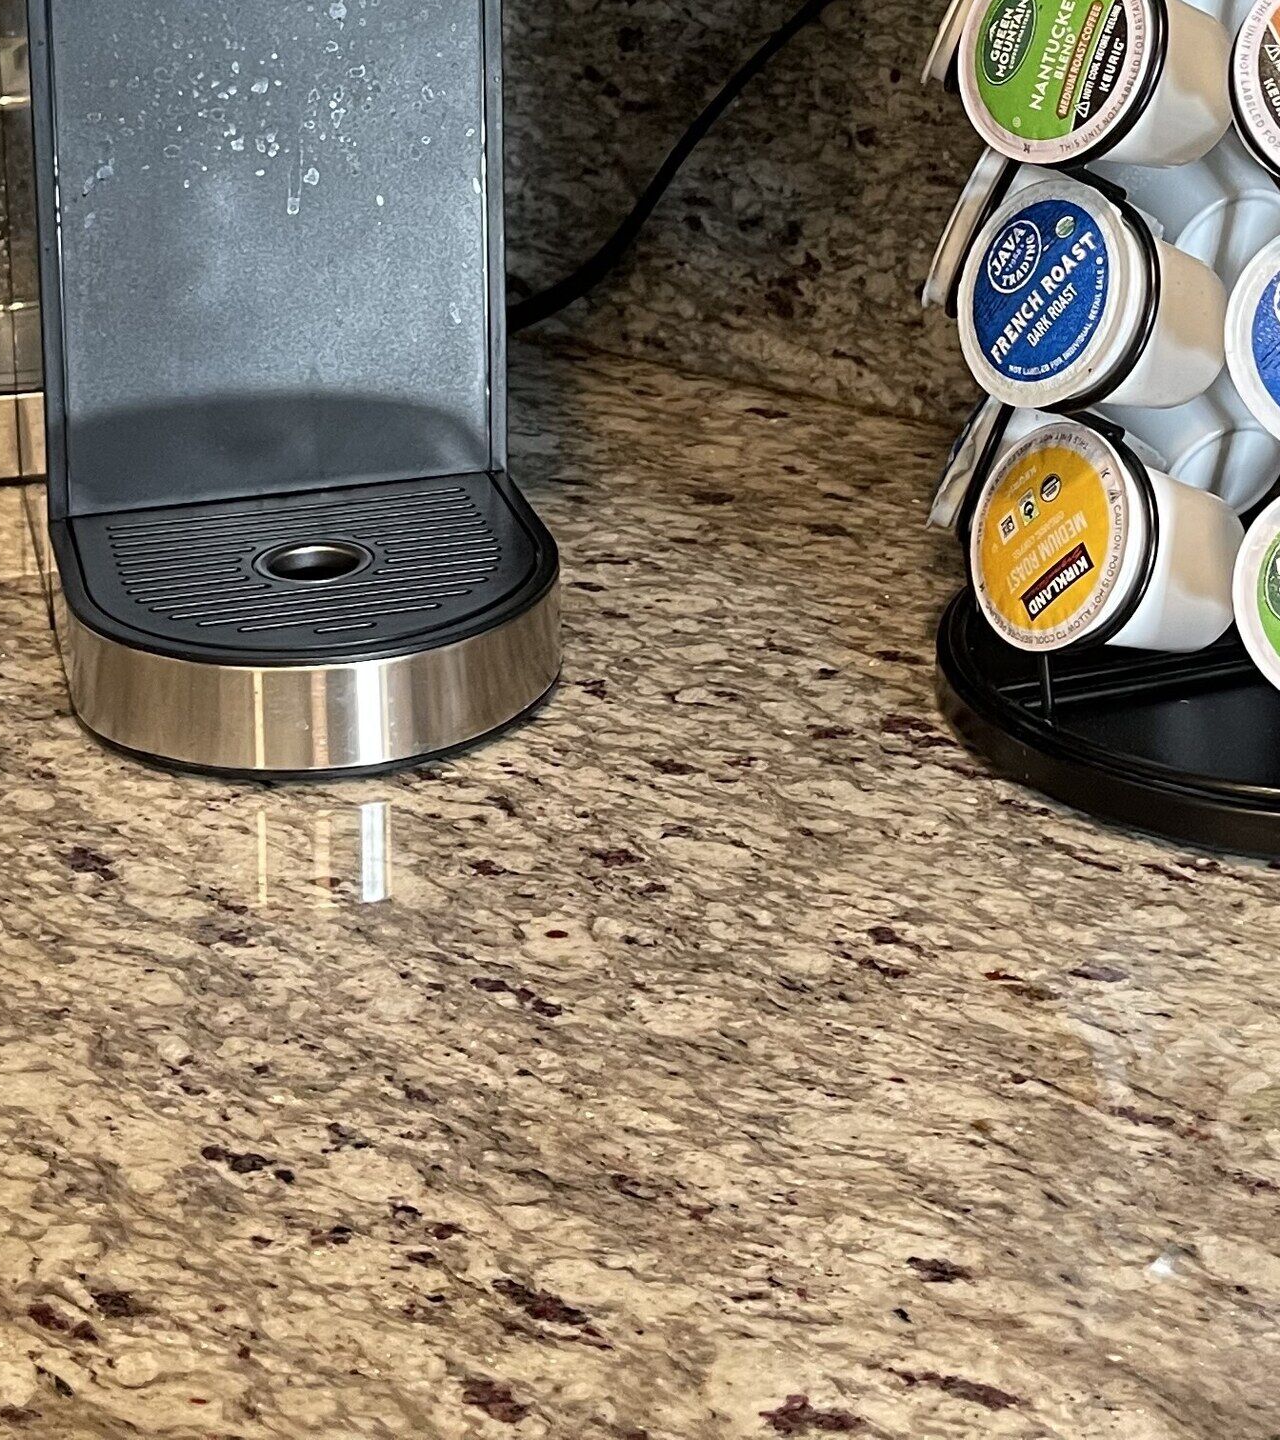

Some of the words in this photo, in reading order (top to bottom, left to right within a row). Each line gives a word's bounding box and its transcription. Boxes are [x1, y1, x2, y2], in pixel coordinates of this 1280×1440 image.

[990, 8, 1015, 62] GREEN
[1253, 0, 1271, 22] THIS
[1053, 33, 1076, 80] BLEND
[1059, 73, 1075, 115] MEDIUM
[1073, 41, 1088, 74] ROAST
[1082, 4, 1102, 42] COFFEE
[1090, 63, 1101, 81] COOL
[1105, 5, 1122, 34] PEELING
[1243, 25, 1257, 50] UNIT
[1099, 39, 1125, 92] KEURIG
[1239, 54, 1249, 76] NOT
[1059, 139, 1081, 153] THIS
[1082, 123, 1102, 142] UNIT
[1102, 105, 1118, 124] NOT
[1118, 61, 1140, 106] LABELED
[1135, 35, 1144, 56] FOR
[1240, 80, 1265, 128] LABELED
[991, 227, 1027, 276] JAVA
[1001, 234, 1036, 286] TRADING
[991, 289, 1043, 364] FRENCH
[1040, 232, 1096, 295] ROAST
[1027, 315, 1051, 347] DARK
[1047, 282, 1078, 320] ROAST
[1009, 365, 1022, 374] NOT
[1041, 511, 1088, 562] MEDIUM
[1114, 504, 1122, 552] CAUTION
[1006, 552, 1042, 593] ROAST
[1028, 556, 1089, 615] KIRKLAND
[1102, 575, 1112, 588] IS
[1107, 554, 1119, 577] POD
[1068, 608, 1093, 633] ALLOW
[1093, 589, 1105, 607] HOT
[1056, 631, 1068, 642] TO
